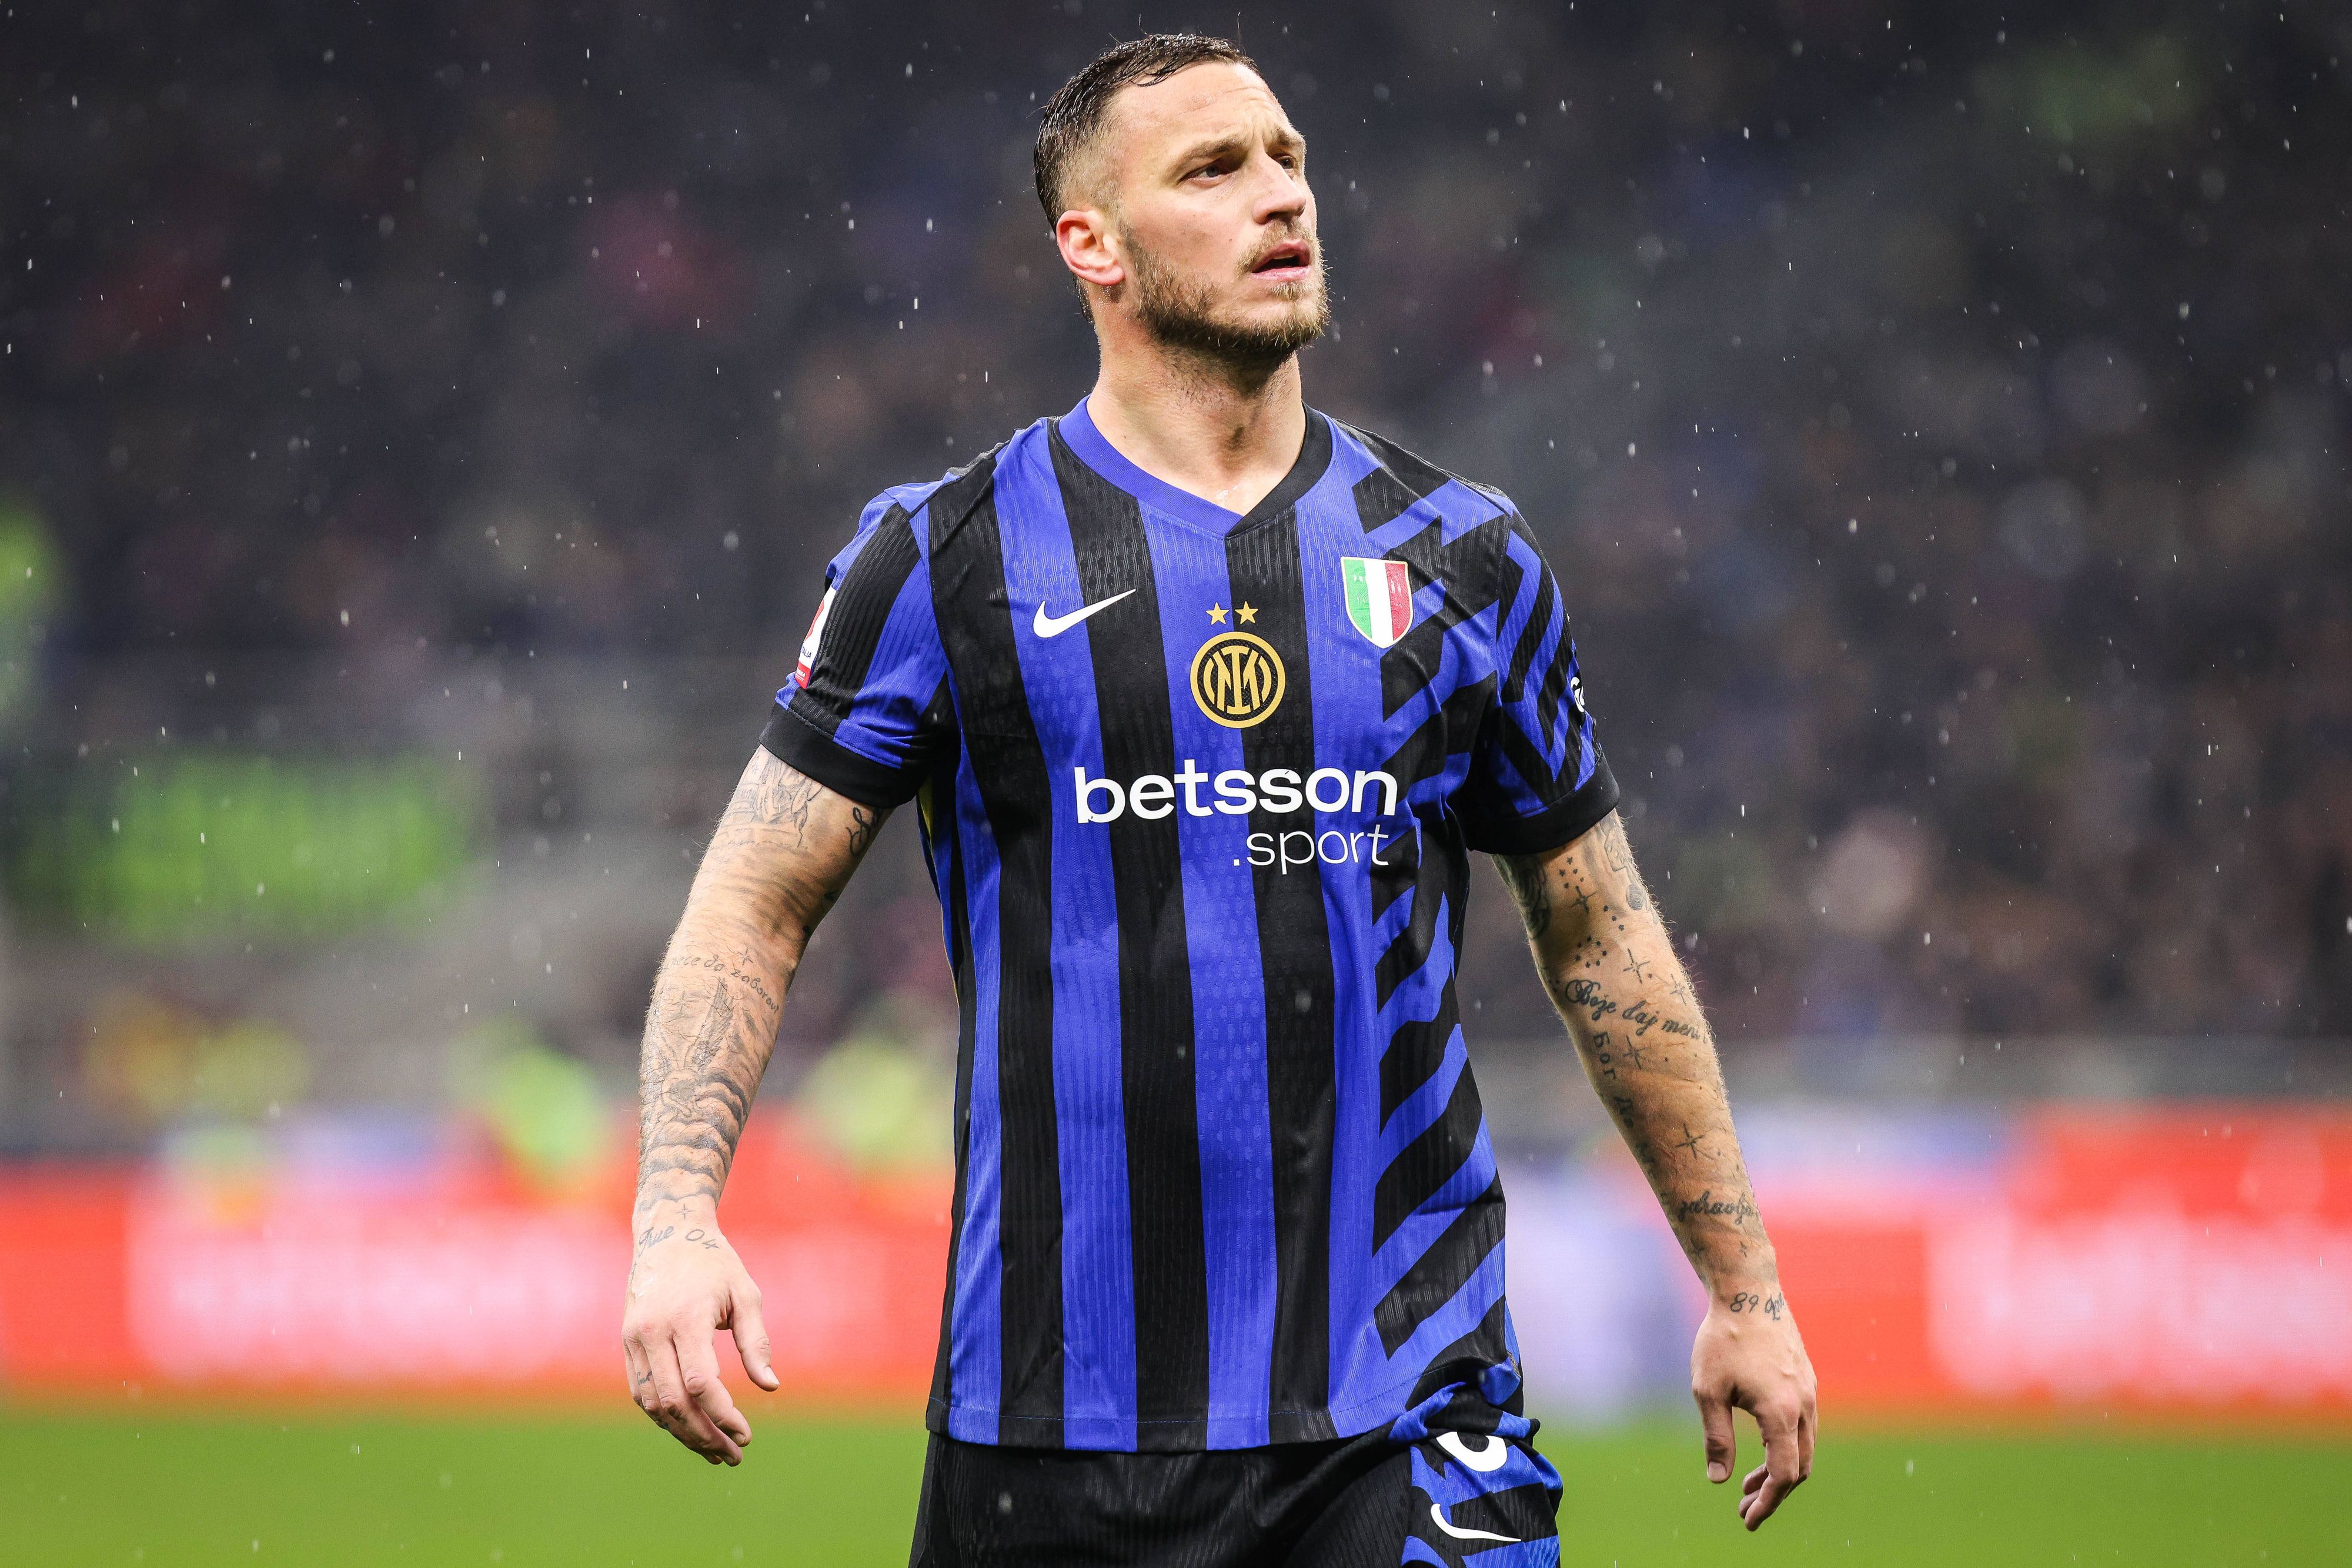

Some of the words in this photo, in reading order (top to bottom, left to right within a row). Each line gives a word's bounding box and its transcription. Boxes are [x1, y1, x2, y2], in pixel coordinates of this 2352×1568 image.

[1074, 759, 1397, 824] betsson
[1234, 824, 1389, 874] .sport
[1622, 1000, 1659, 1036] daj
[1730, 1292, 1759, 1313] 89
